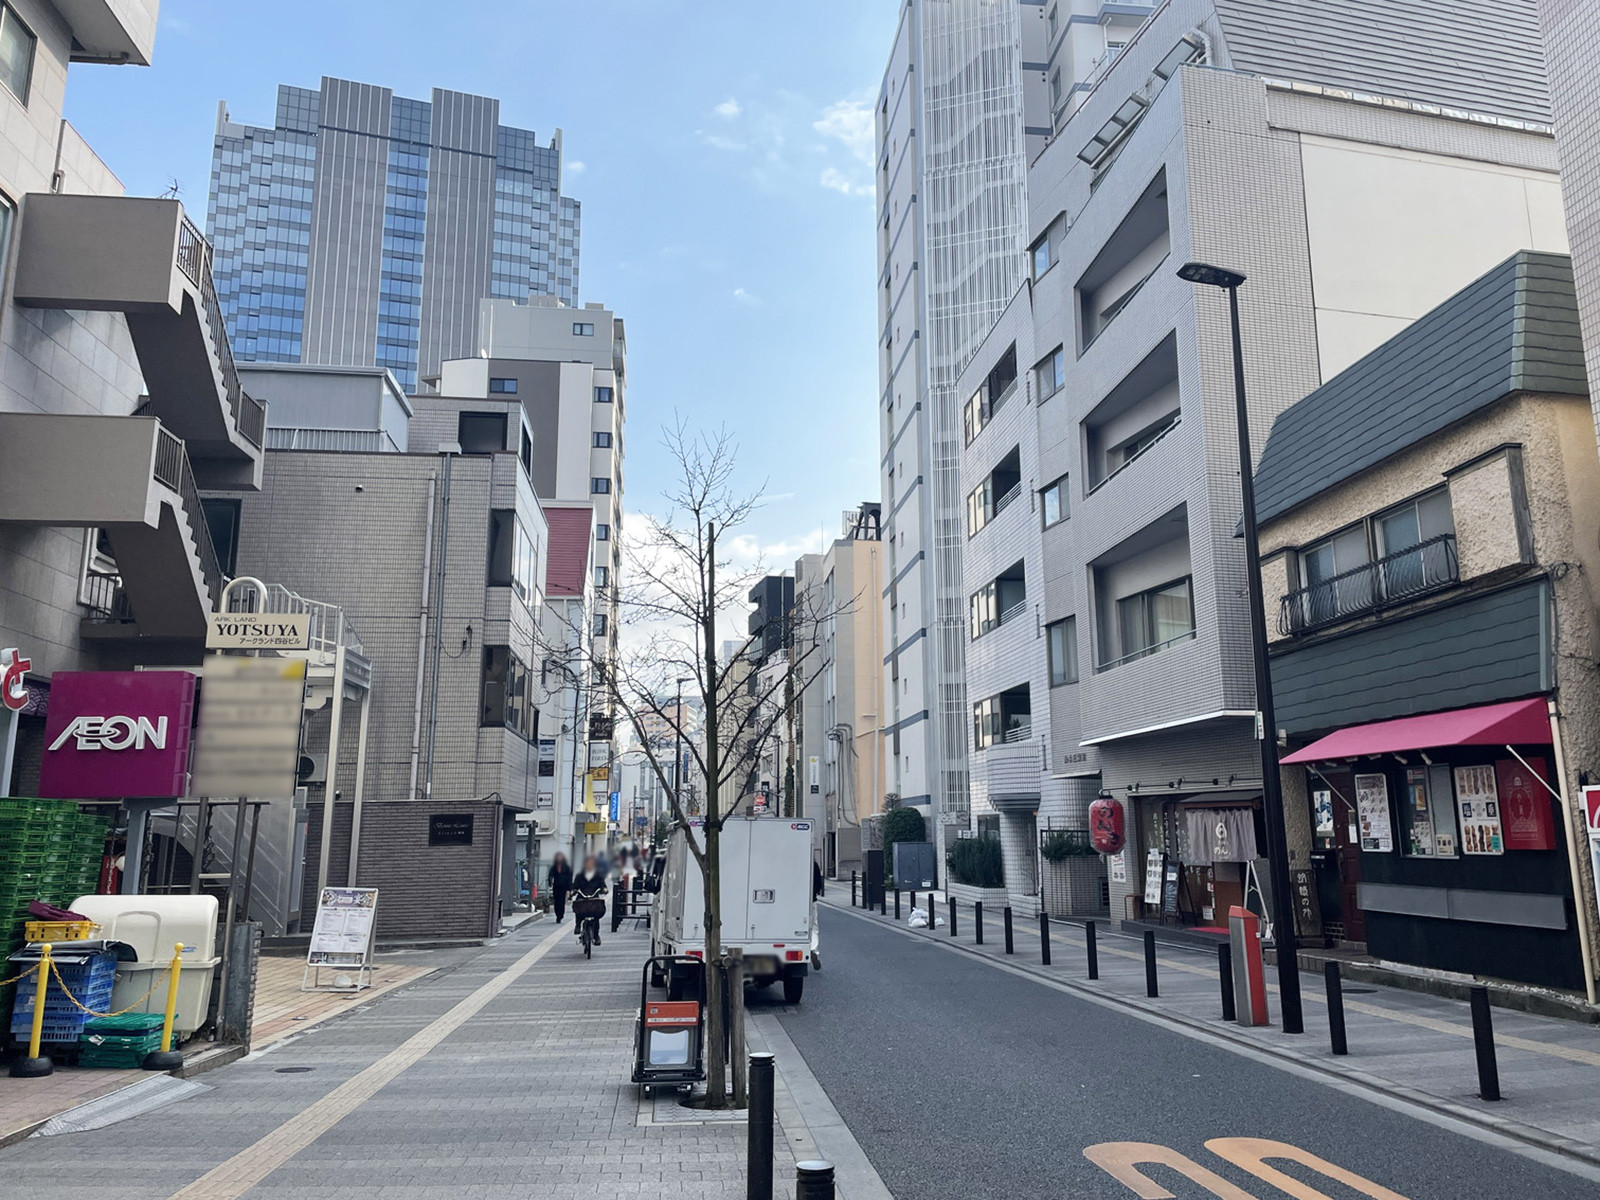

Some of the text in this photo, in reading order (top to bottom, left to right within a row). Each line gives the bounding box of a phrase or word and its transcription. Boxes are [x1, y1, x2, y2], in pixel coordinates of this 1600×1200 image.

[216, 623, 299, 637] YOTSUYA
[239, 637, 302, 645] アークランド四谷ビル
[47, 715, 169, 751] AEON
